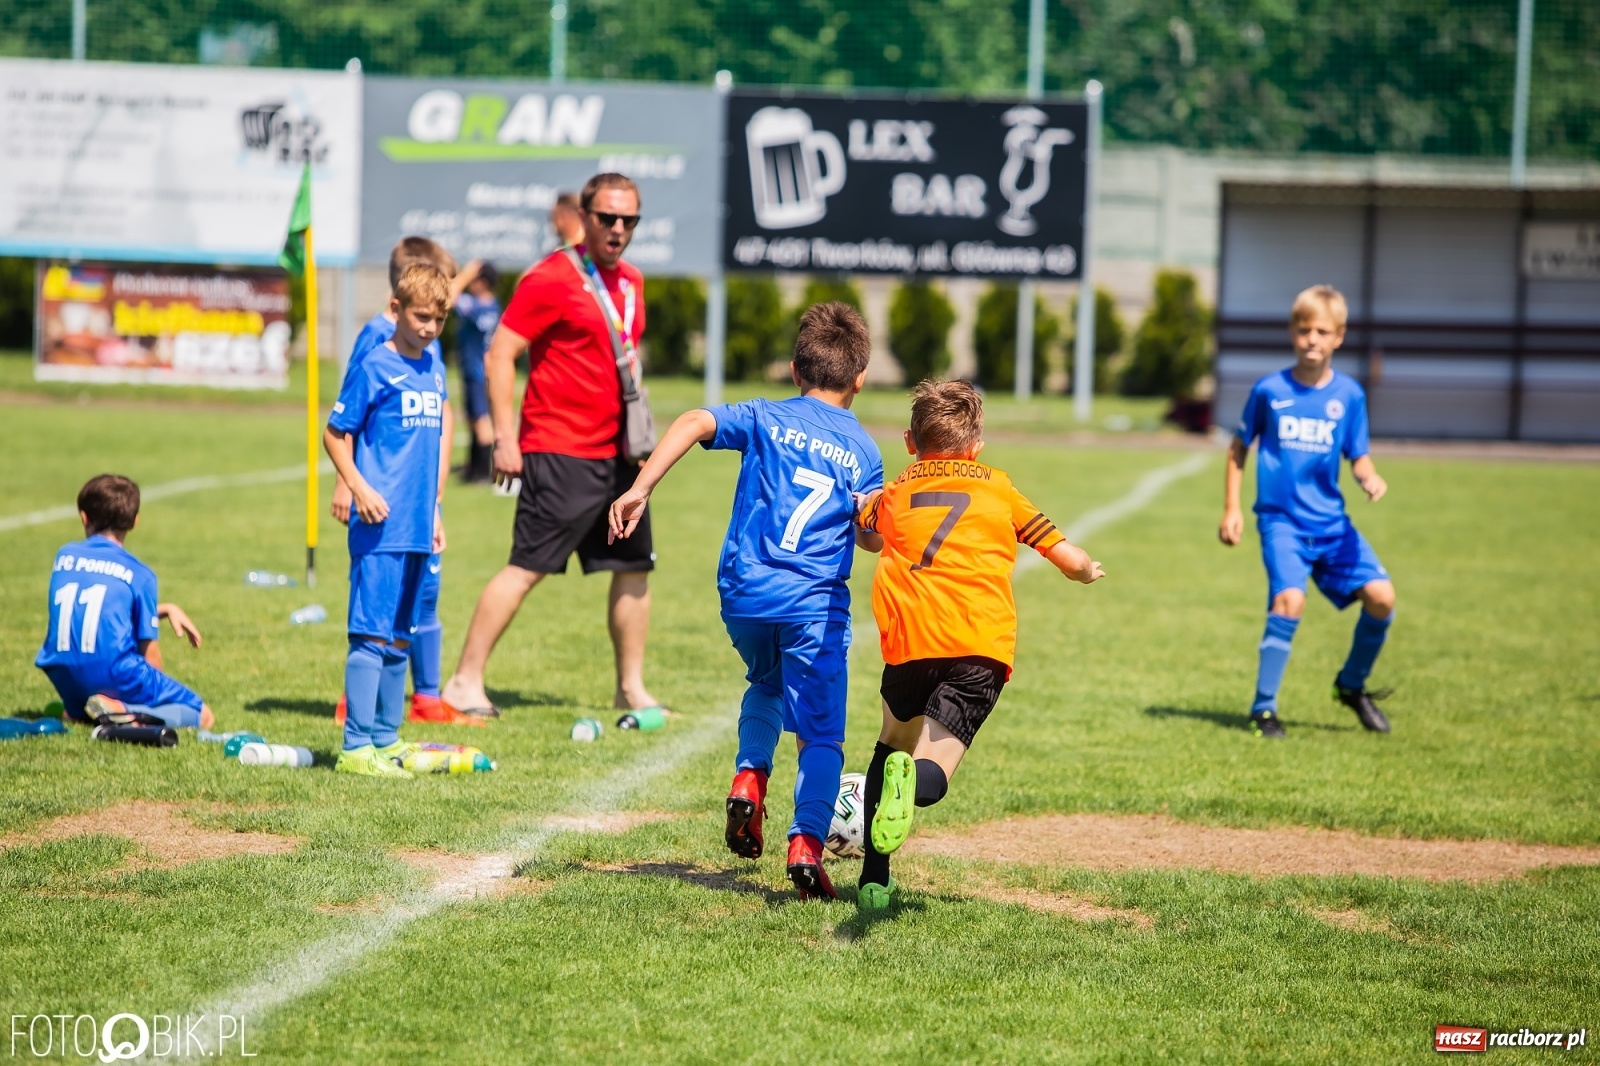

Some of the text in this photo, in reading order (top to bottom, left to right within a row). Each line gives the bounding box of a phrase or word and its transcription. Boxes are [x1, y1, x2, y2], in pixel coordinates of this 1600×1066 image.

[408, 90, 604, 146] GRAN
[848, 119, 935, 162] LEX
[891, 172, 988, 218] BAR
[770, 425, 807, 449] 1.FC
[1278, 414, 1337, 446] DEK
[779, 466, 836, 553] 7
[910, 491, 971, 571] 7
[75, 556, 134, 585] PORUBA
[54, 582, 107, 654] 11
